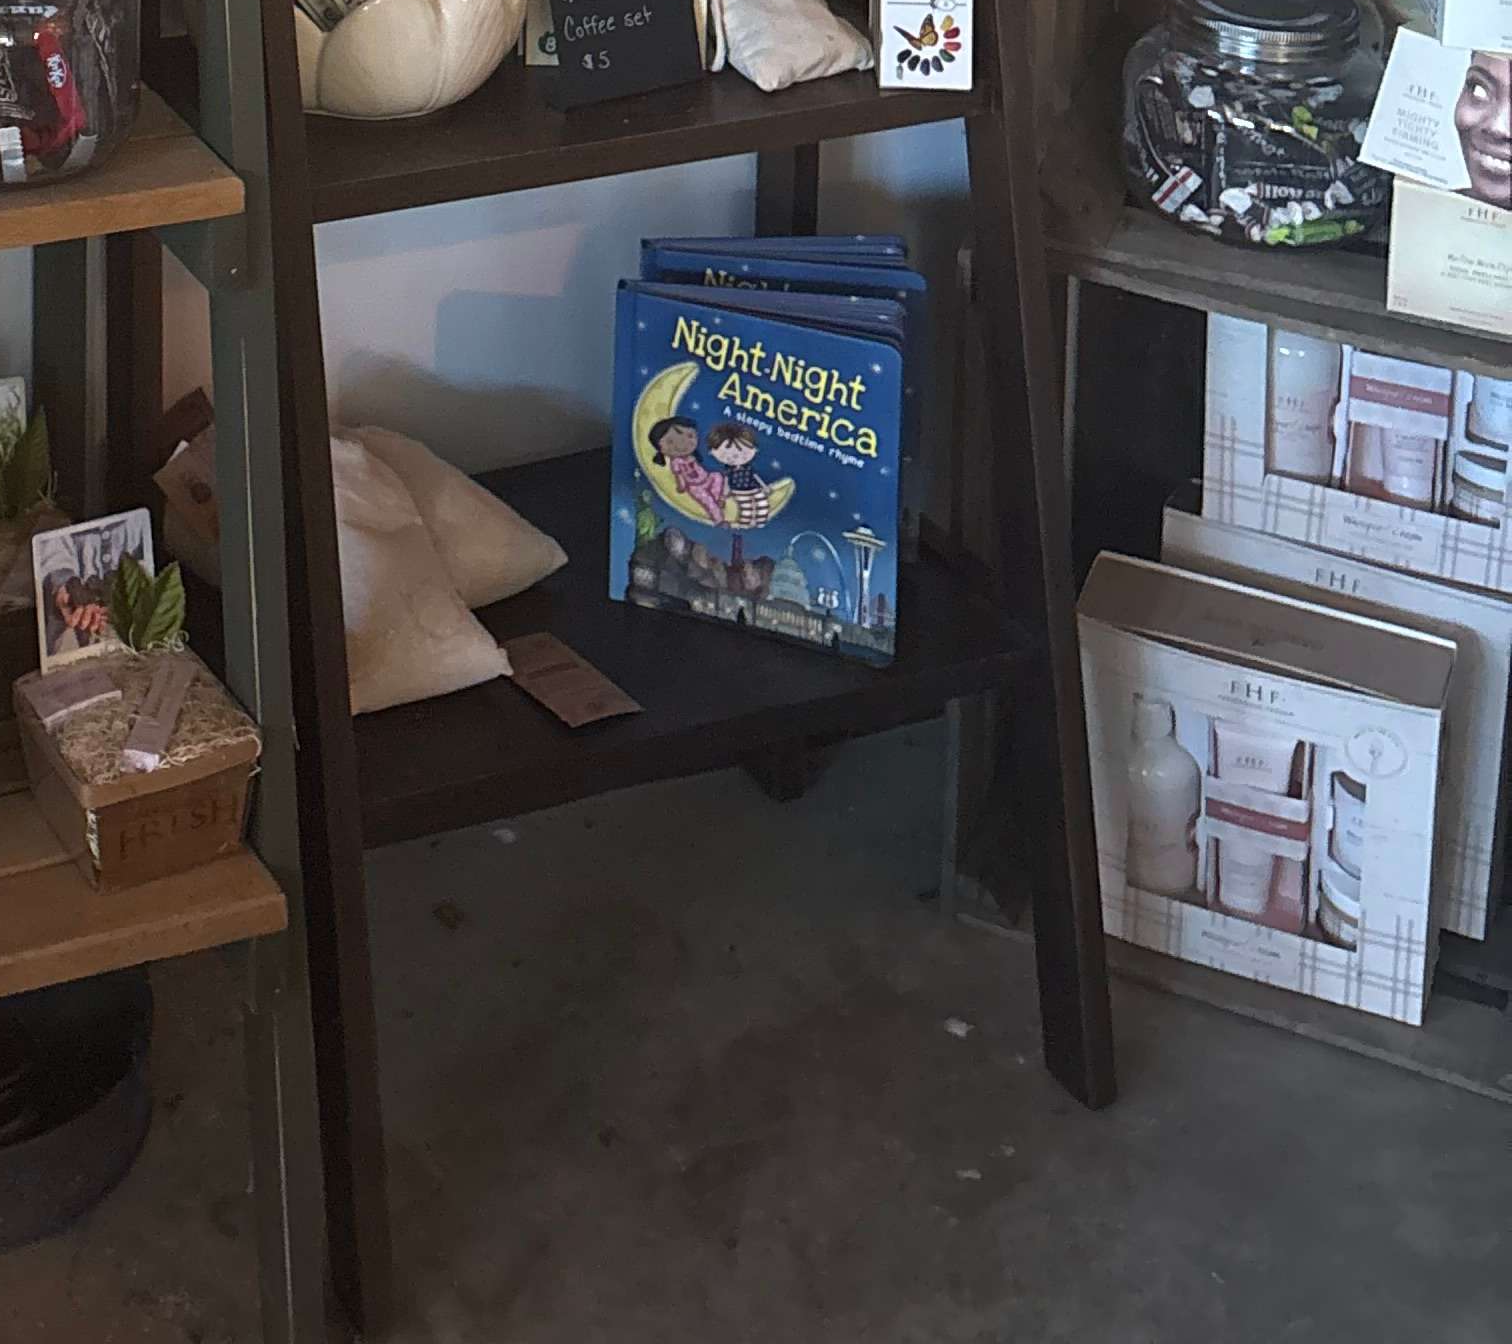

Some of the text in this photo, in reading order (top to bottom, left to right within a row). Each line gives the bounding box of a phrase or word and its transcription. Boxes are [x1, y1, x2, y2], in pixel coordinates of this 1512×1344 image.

[564, 5, 652, 41] Coffee set
[545, 37, 557, 52] 8
[582, 50, 610, 69] $5
[717, 372, 878, 458] America
[723, 405, 865, 469] A sleepy bedtime rhyme
[1230, 680, 1281, 704] FHF
